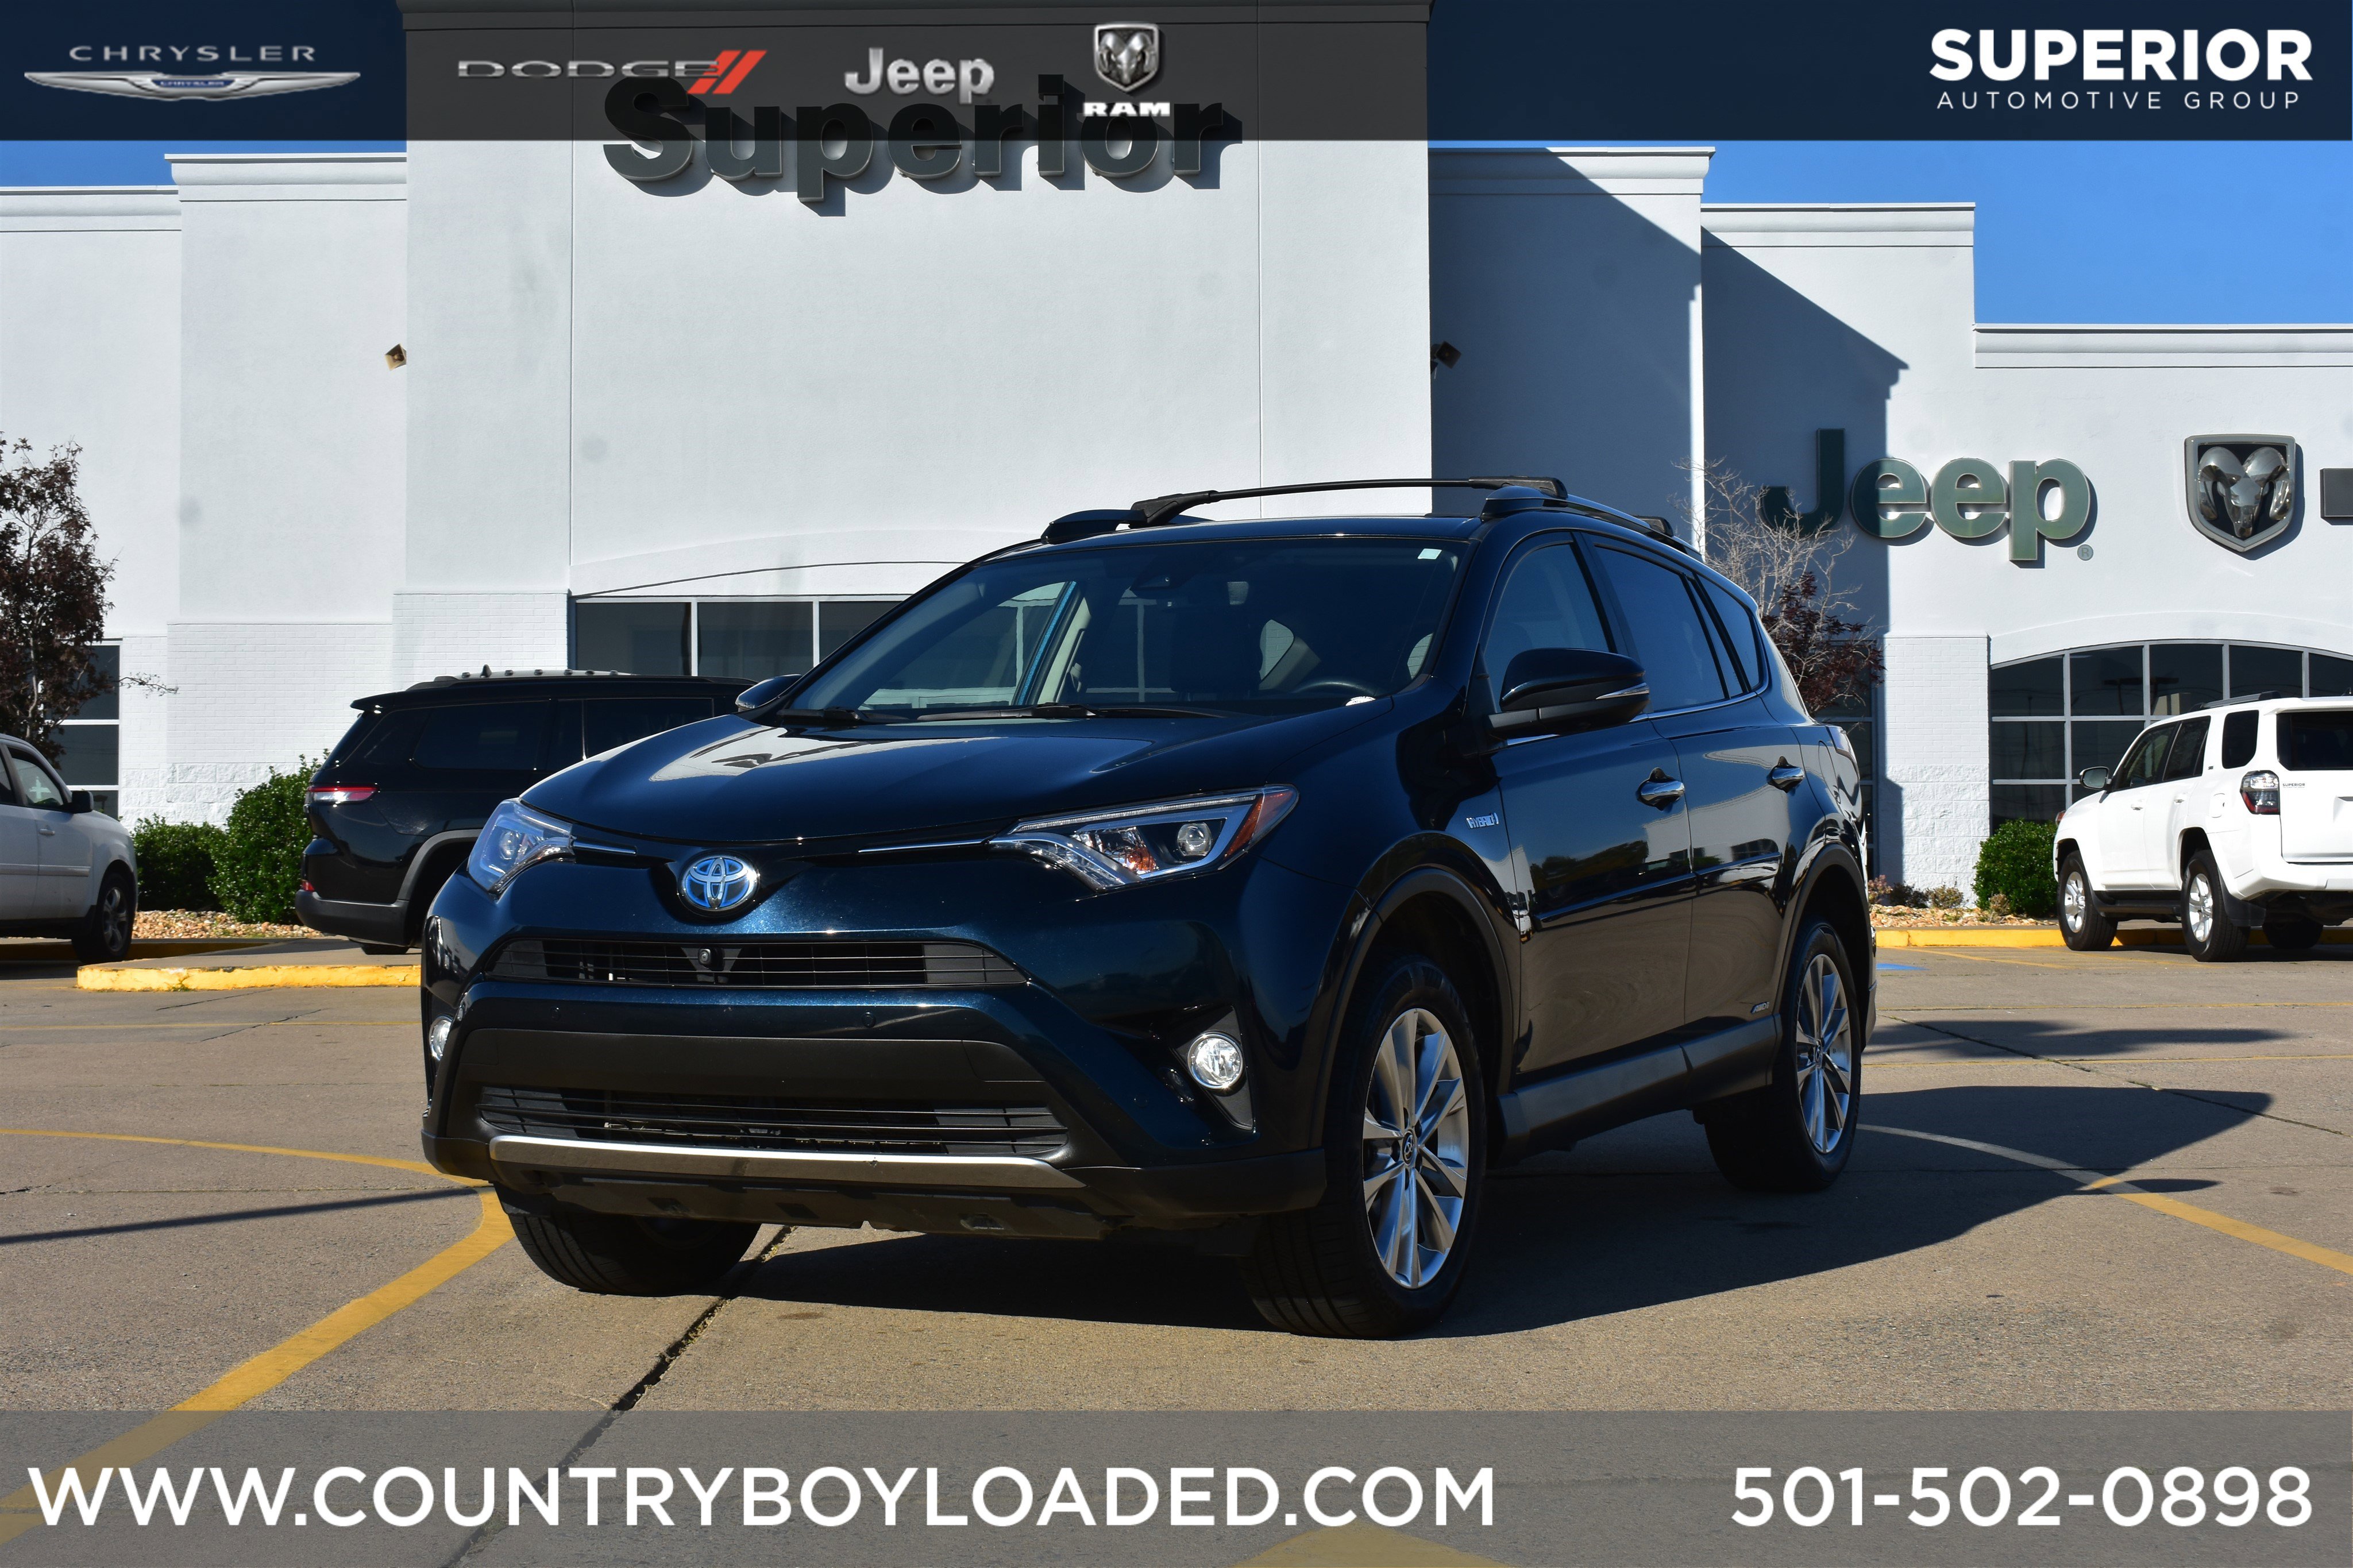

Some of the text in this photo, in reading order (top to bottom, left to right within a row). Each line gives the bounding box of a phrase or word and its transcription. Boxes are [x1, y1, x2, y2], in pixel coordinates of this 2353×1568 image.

[604, 74, 1222, 202] Superior
[1761, 428, 2090, 561] Jeep
[1466, 812, 1499, 829] HYBRID
